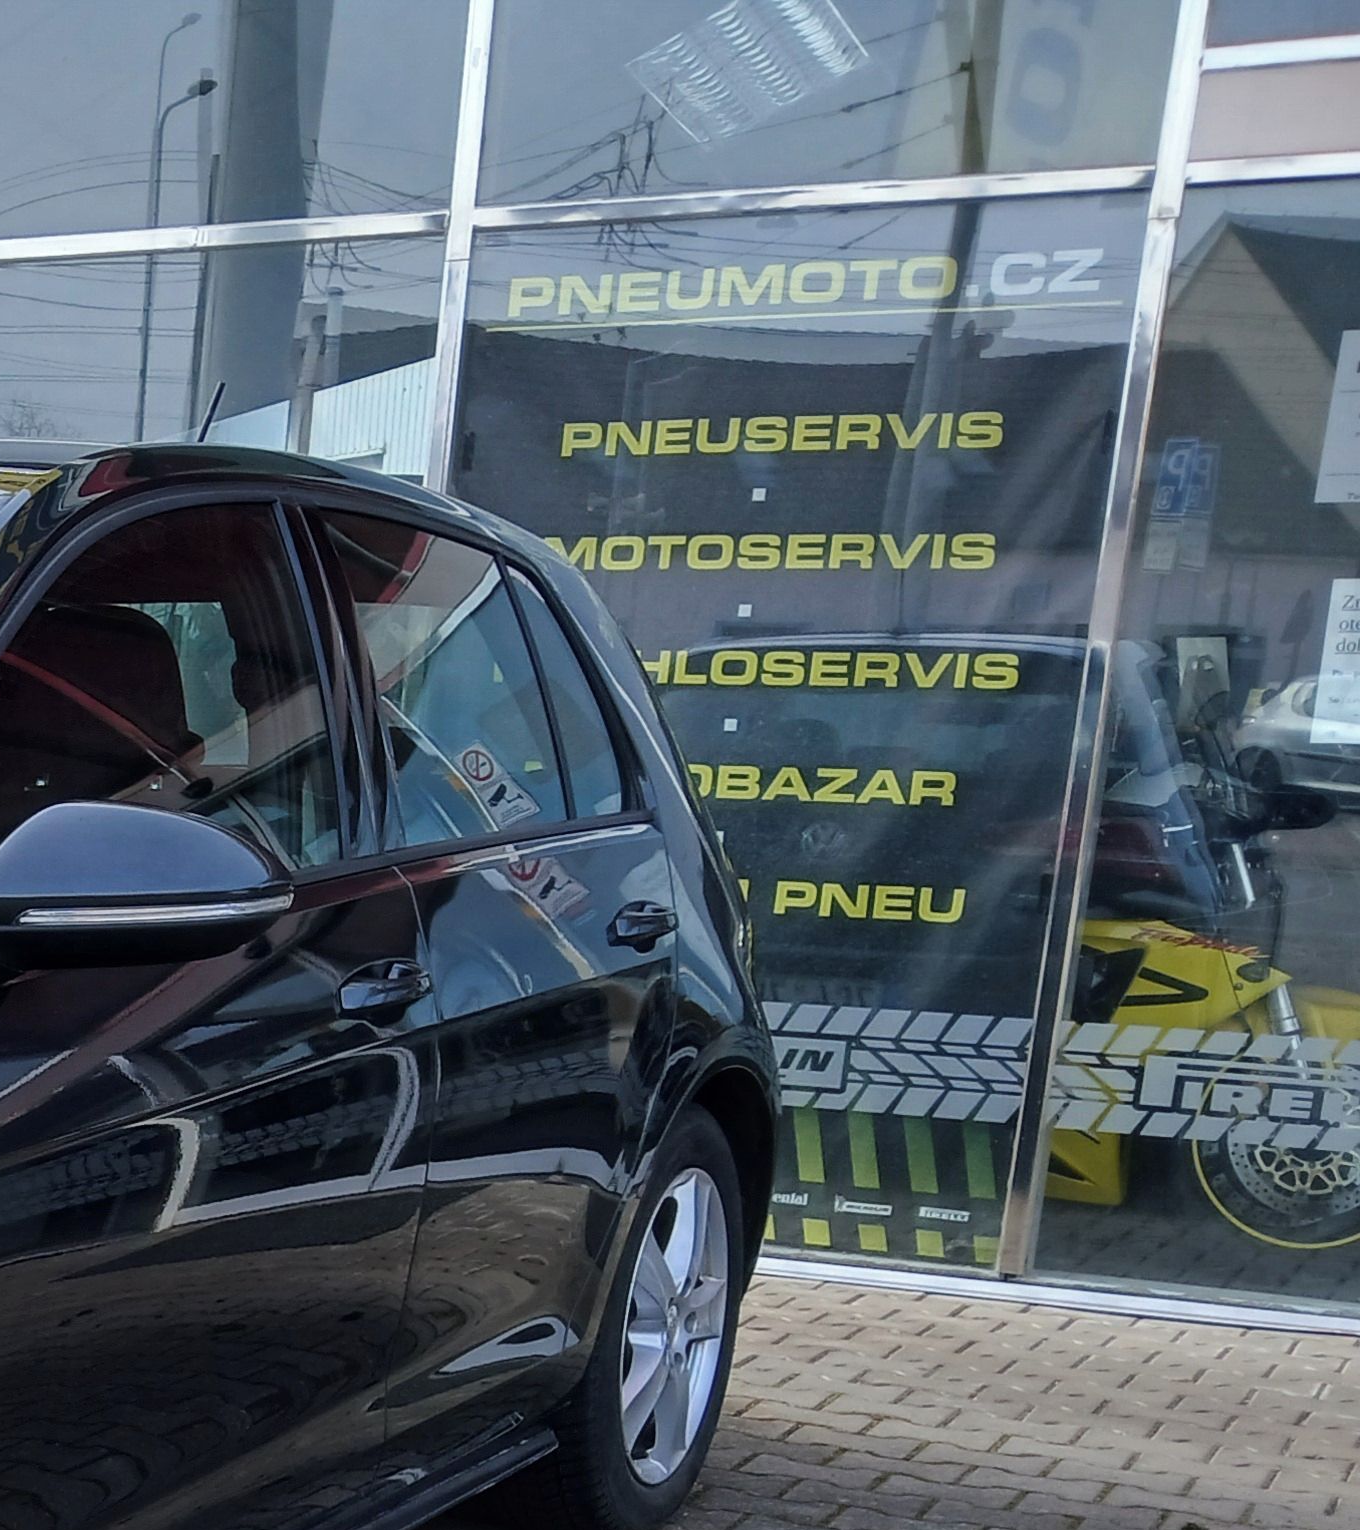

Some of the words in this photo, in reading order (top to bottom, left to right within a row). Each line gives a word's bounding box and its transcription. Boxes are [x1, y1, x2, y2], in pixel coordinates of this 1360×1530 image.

[507, 249, 1104, 317] PNEUMOTO.CZ
[560, 411, 1004, 457] PNEUSERVIS
[544, 532, 997, 572] MOTOSERVIS
[773, 880, 966, 924] PNEU
